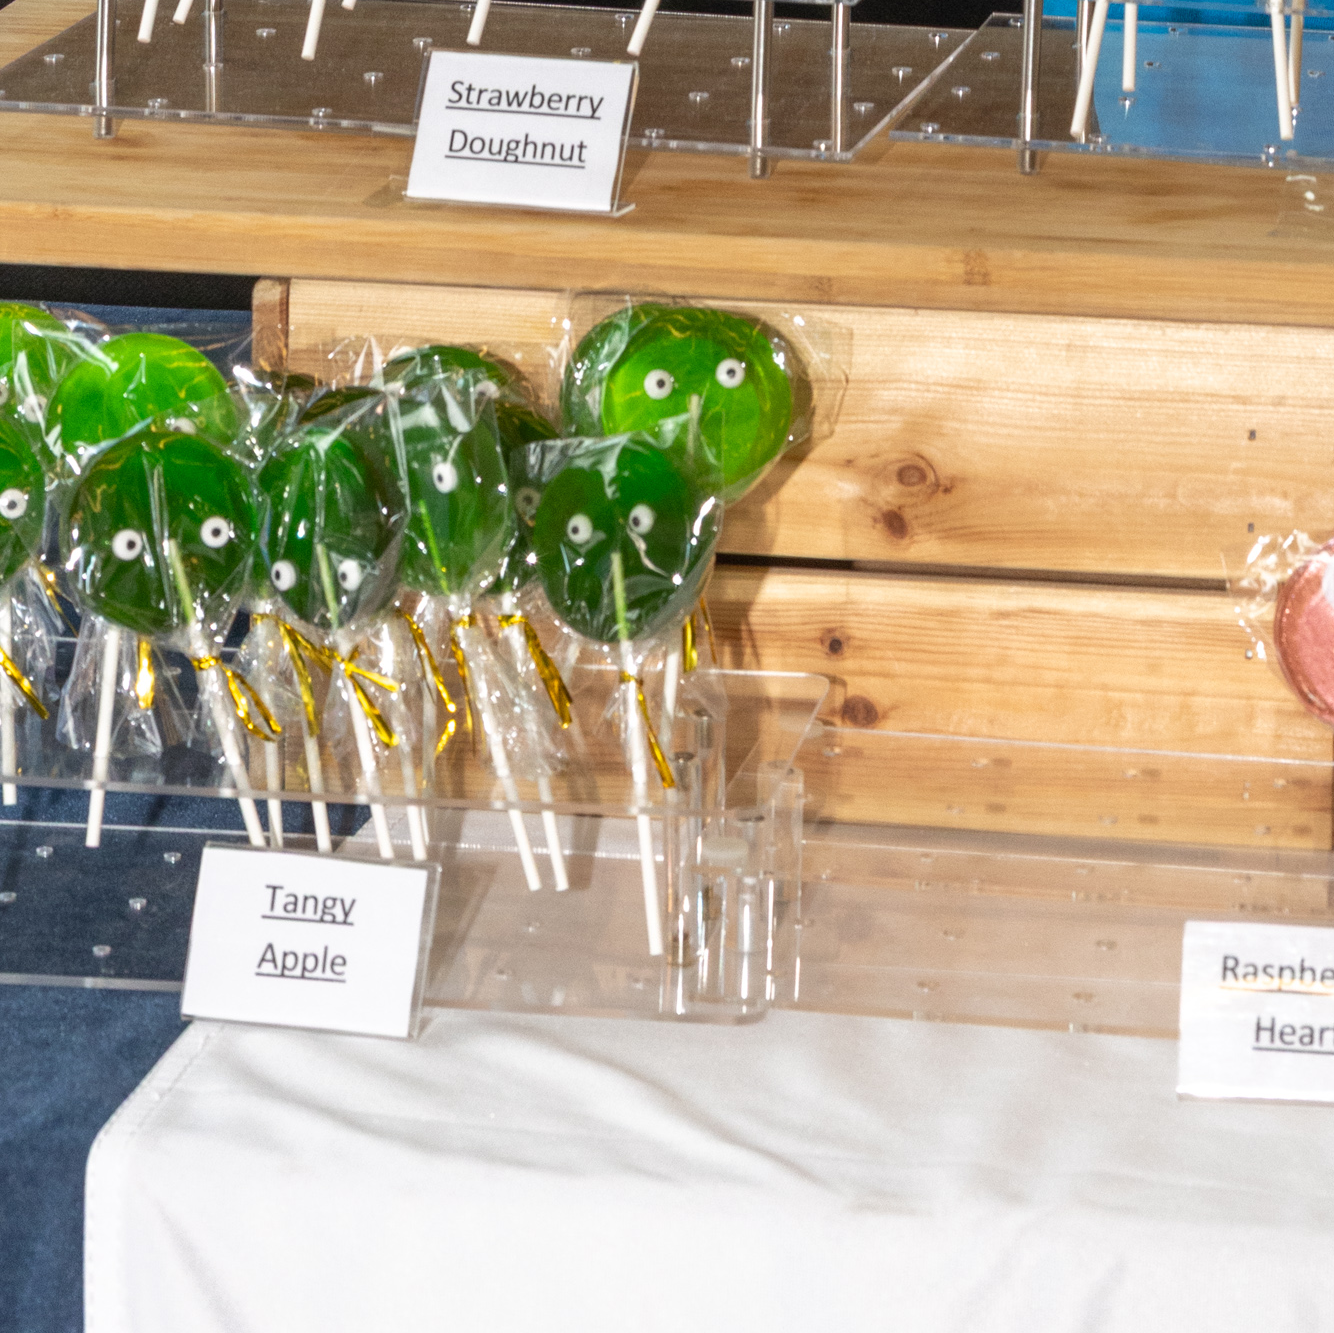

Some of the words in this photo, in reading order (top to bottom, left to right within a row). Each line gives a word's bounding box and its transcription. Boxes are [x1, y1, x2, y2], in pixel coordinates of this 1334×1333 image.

[447, 80, 605, 120] Strawberry
[447, 129, 588, 165] Doughnut
[265, 884, 357, 925] Tangy
[257, 942, 348, 978] Apple
